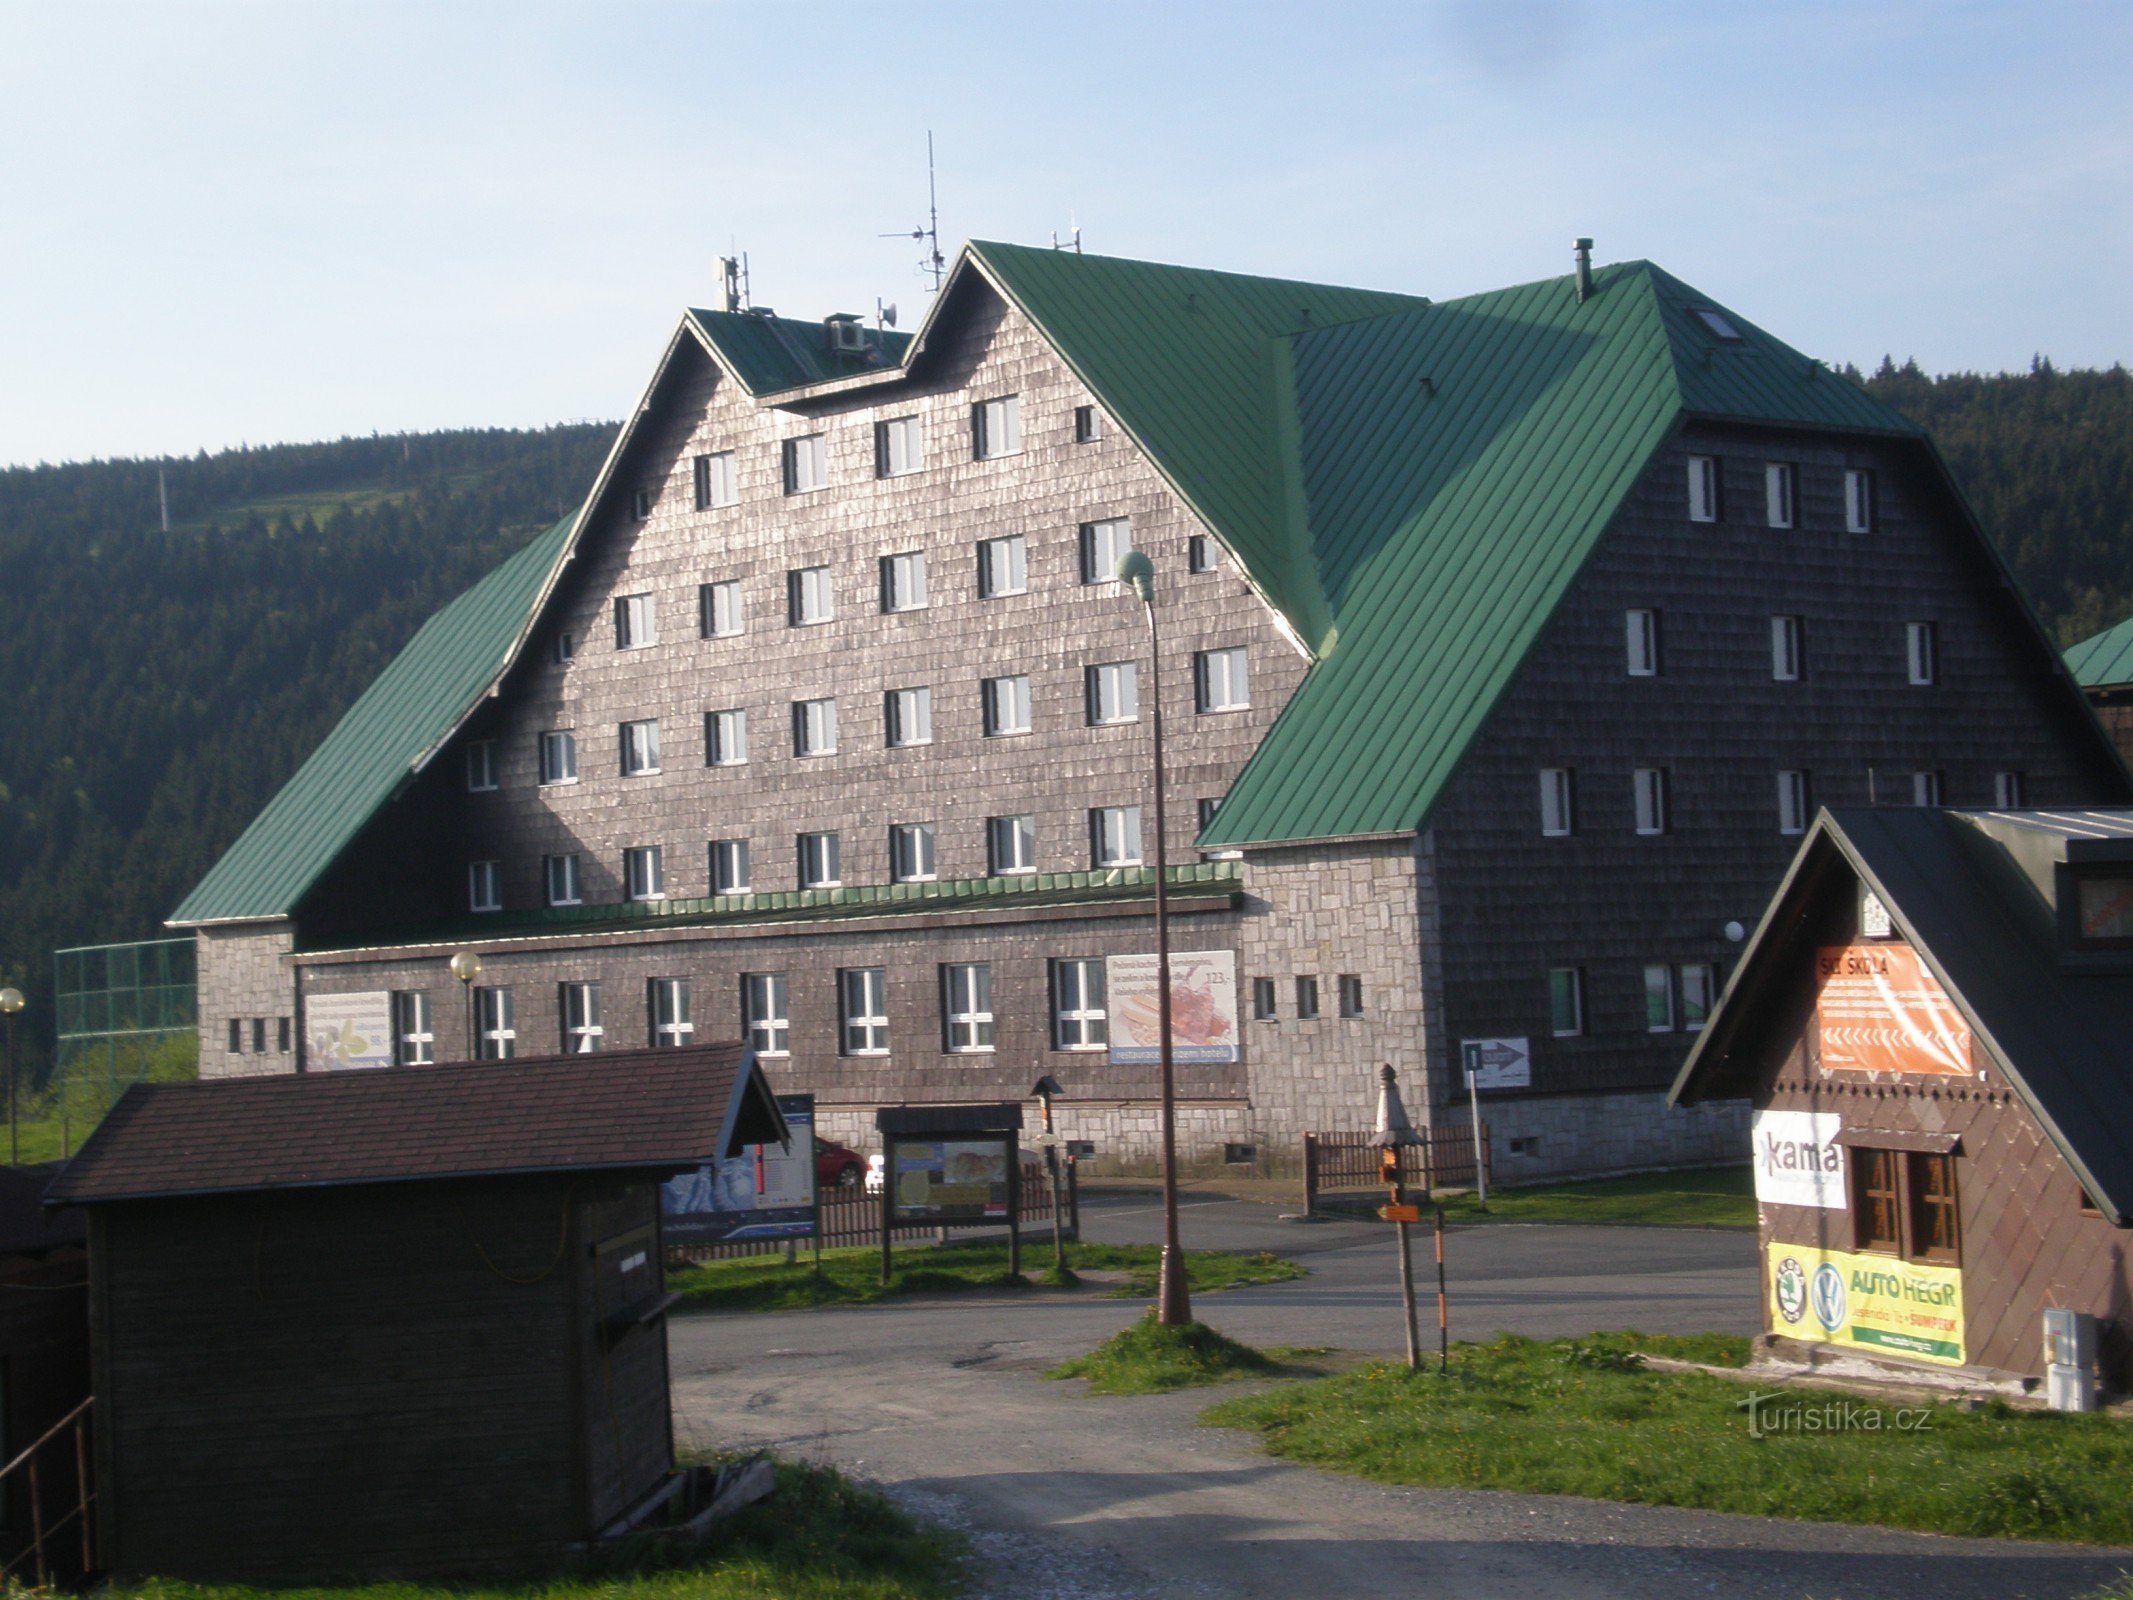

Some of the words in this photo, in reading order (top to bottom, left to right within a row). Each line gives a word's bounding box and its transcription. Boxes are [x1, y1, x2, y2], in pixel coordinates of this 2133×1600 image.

[1821, 957, 1841, 975] SKI
[1848, 951, 1889, 975] ŠKOLA
[1766, 1132, 1840, 1177] kama
[1851, 1270, 1900, 1298] AUTO
[1903, 1277, 1956, 1307] HEGR
